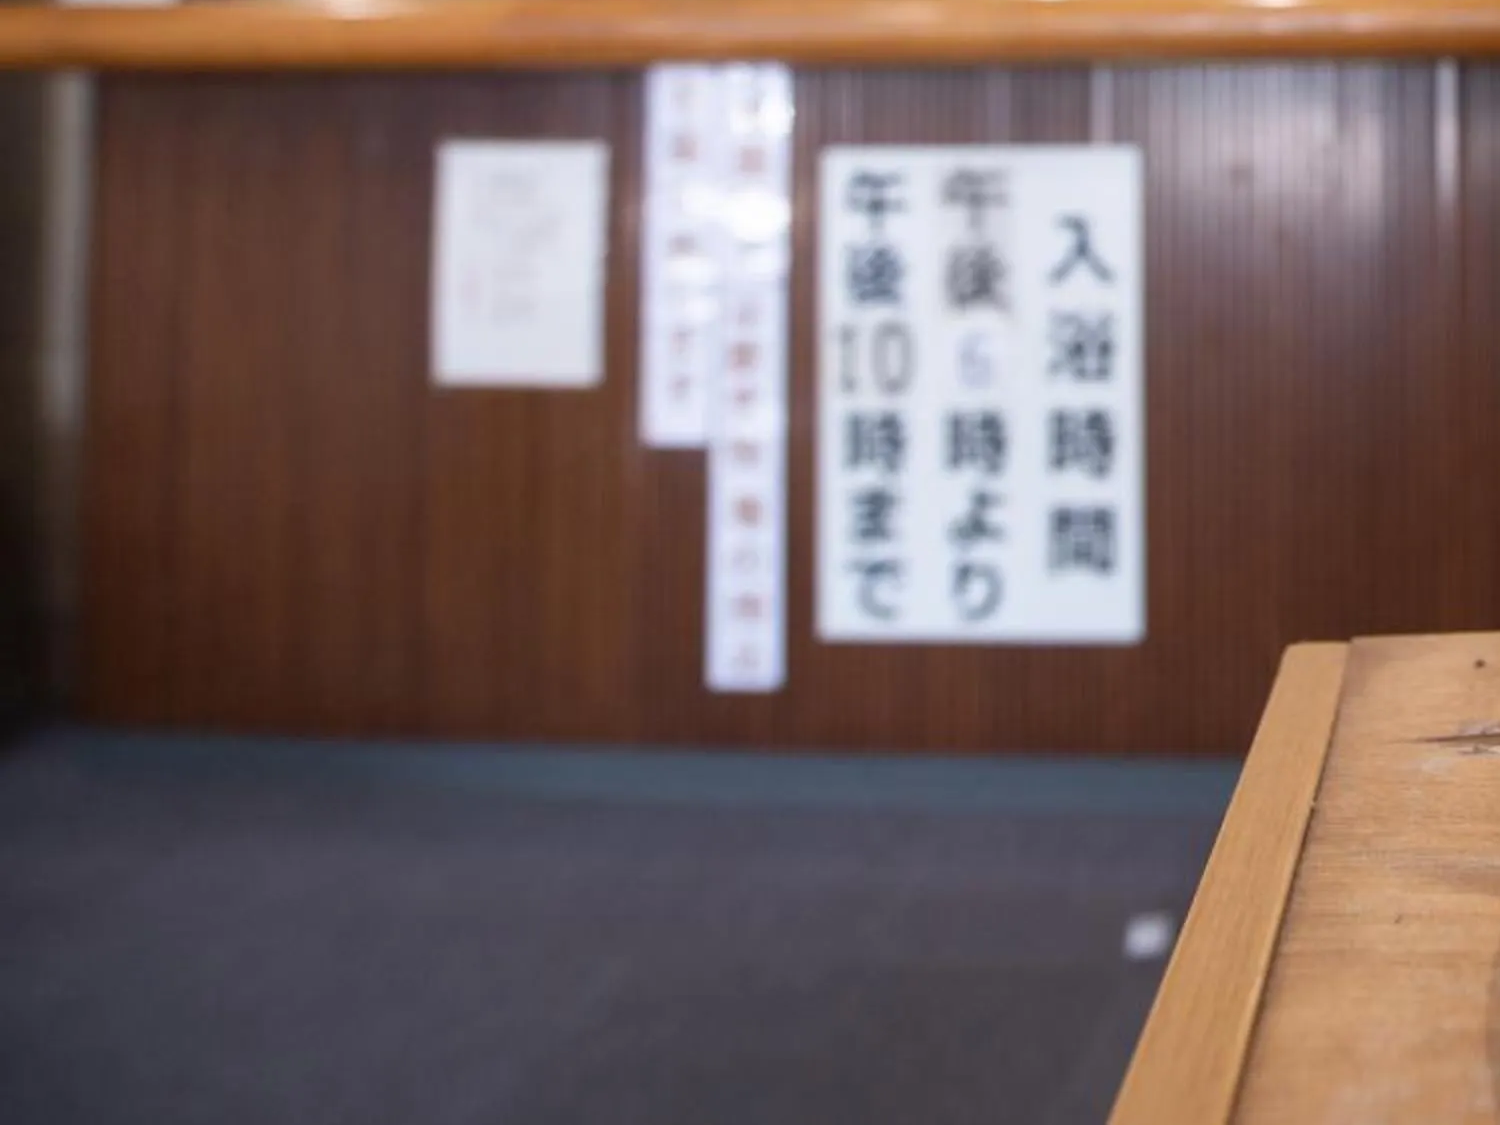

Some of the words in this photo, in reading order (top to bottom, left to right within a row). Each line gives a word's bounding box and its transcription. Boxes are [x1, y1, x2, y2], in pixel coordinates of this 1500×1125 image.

[839, 173, 912, 621] 午後10時まで
[1046, 211, 1116, 577] 入浴時間
